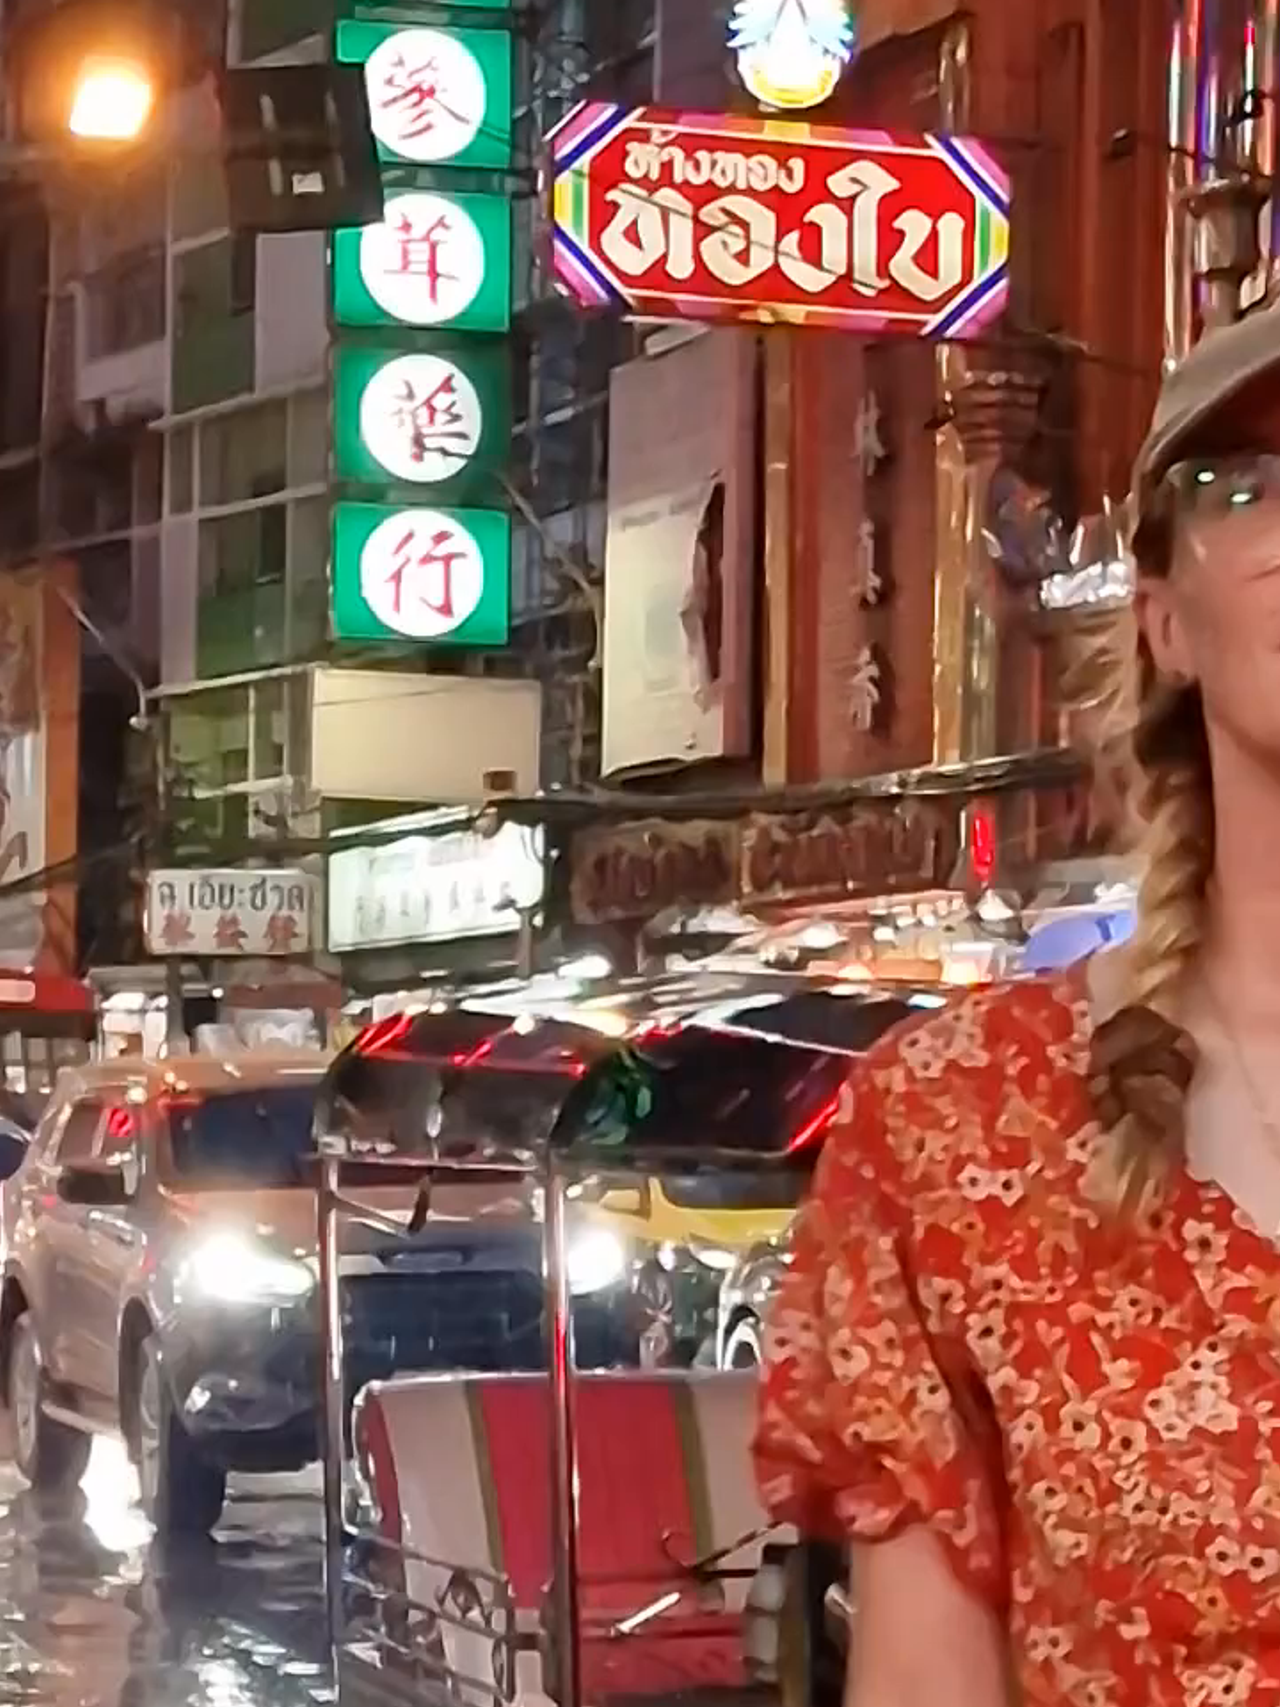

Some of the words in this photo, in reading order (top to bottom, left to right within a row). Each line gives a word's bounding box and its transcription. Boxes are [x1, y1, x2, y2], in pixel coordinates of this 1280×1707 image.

[623, 128, 806, 193] ห้างทอง
[600, 159, 966, 301] ทองใบ
